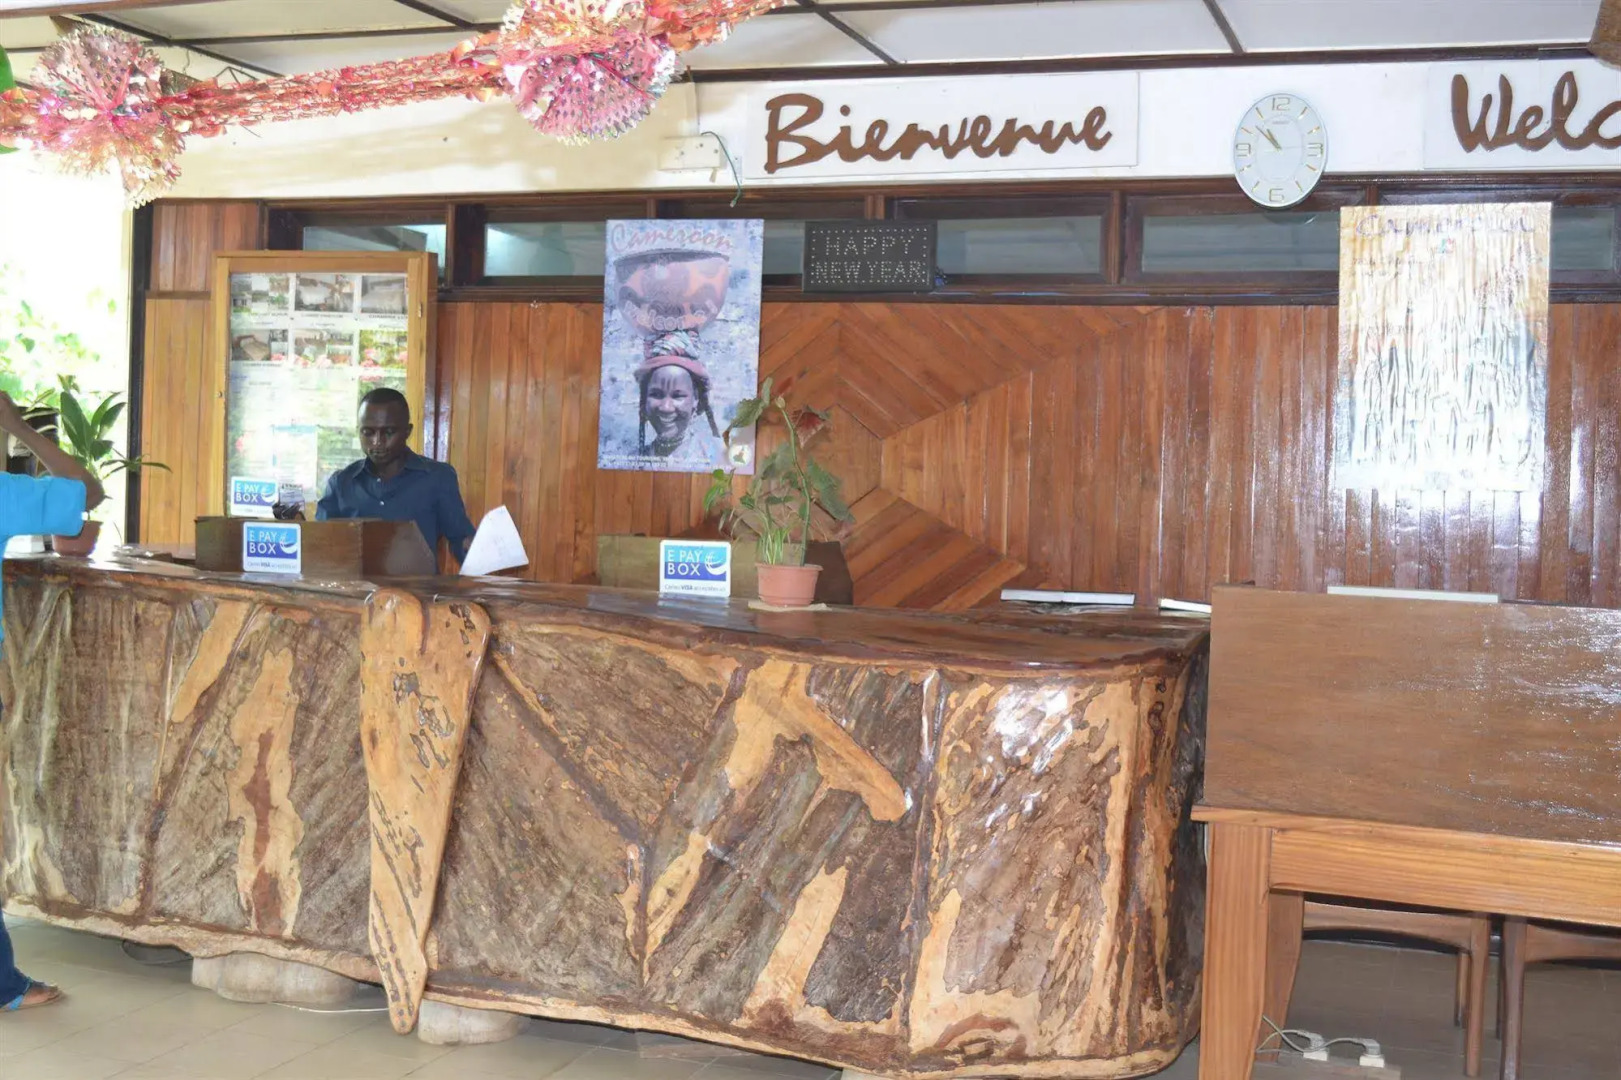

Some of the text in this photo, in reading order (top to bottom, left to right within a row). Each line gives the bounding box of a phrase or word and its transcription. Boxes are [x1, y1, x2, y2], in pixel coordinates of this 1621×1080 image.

[1272, 97, 1290, 111] 12
[764, 92, 1113, 175] Bienvenue
[1236, 142, 1251, 157] 9
[1307, 142, 1323, 157] 3
[1269, 188, 1285, 202] 6
[611, 223, 734, 252] Cameroon
[826, 236, 914, 255] HAPPY
[816, 261, 921, 279] NEW YEAR
[244, 483, 259, 493] PAY
[236, 492, 258, 503] BOX
[249, 530, 277, 542] E PAY
[249, 542, 276, 555] BOX
[668, 550, 703, 563] E PAY
[668, 563, 701, 576] BOX
